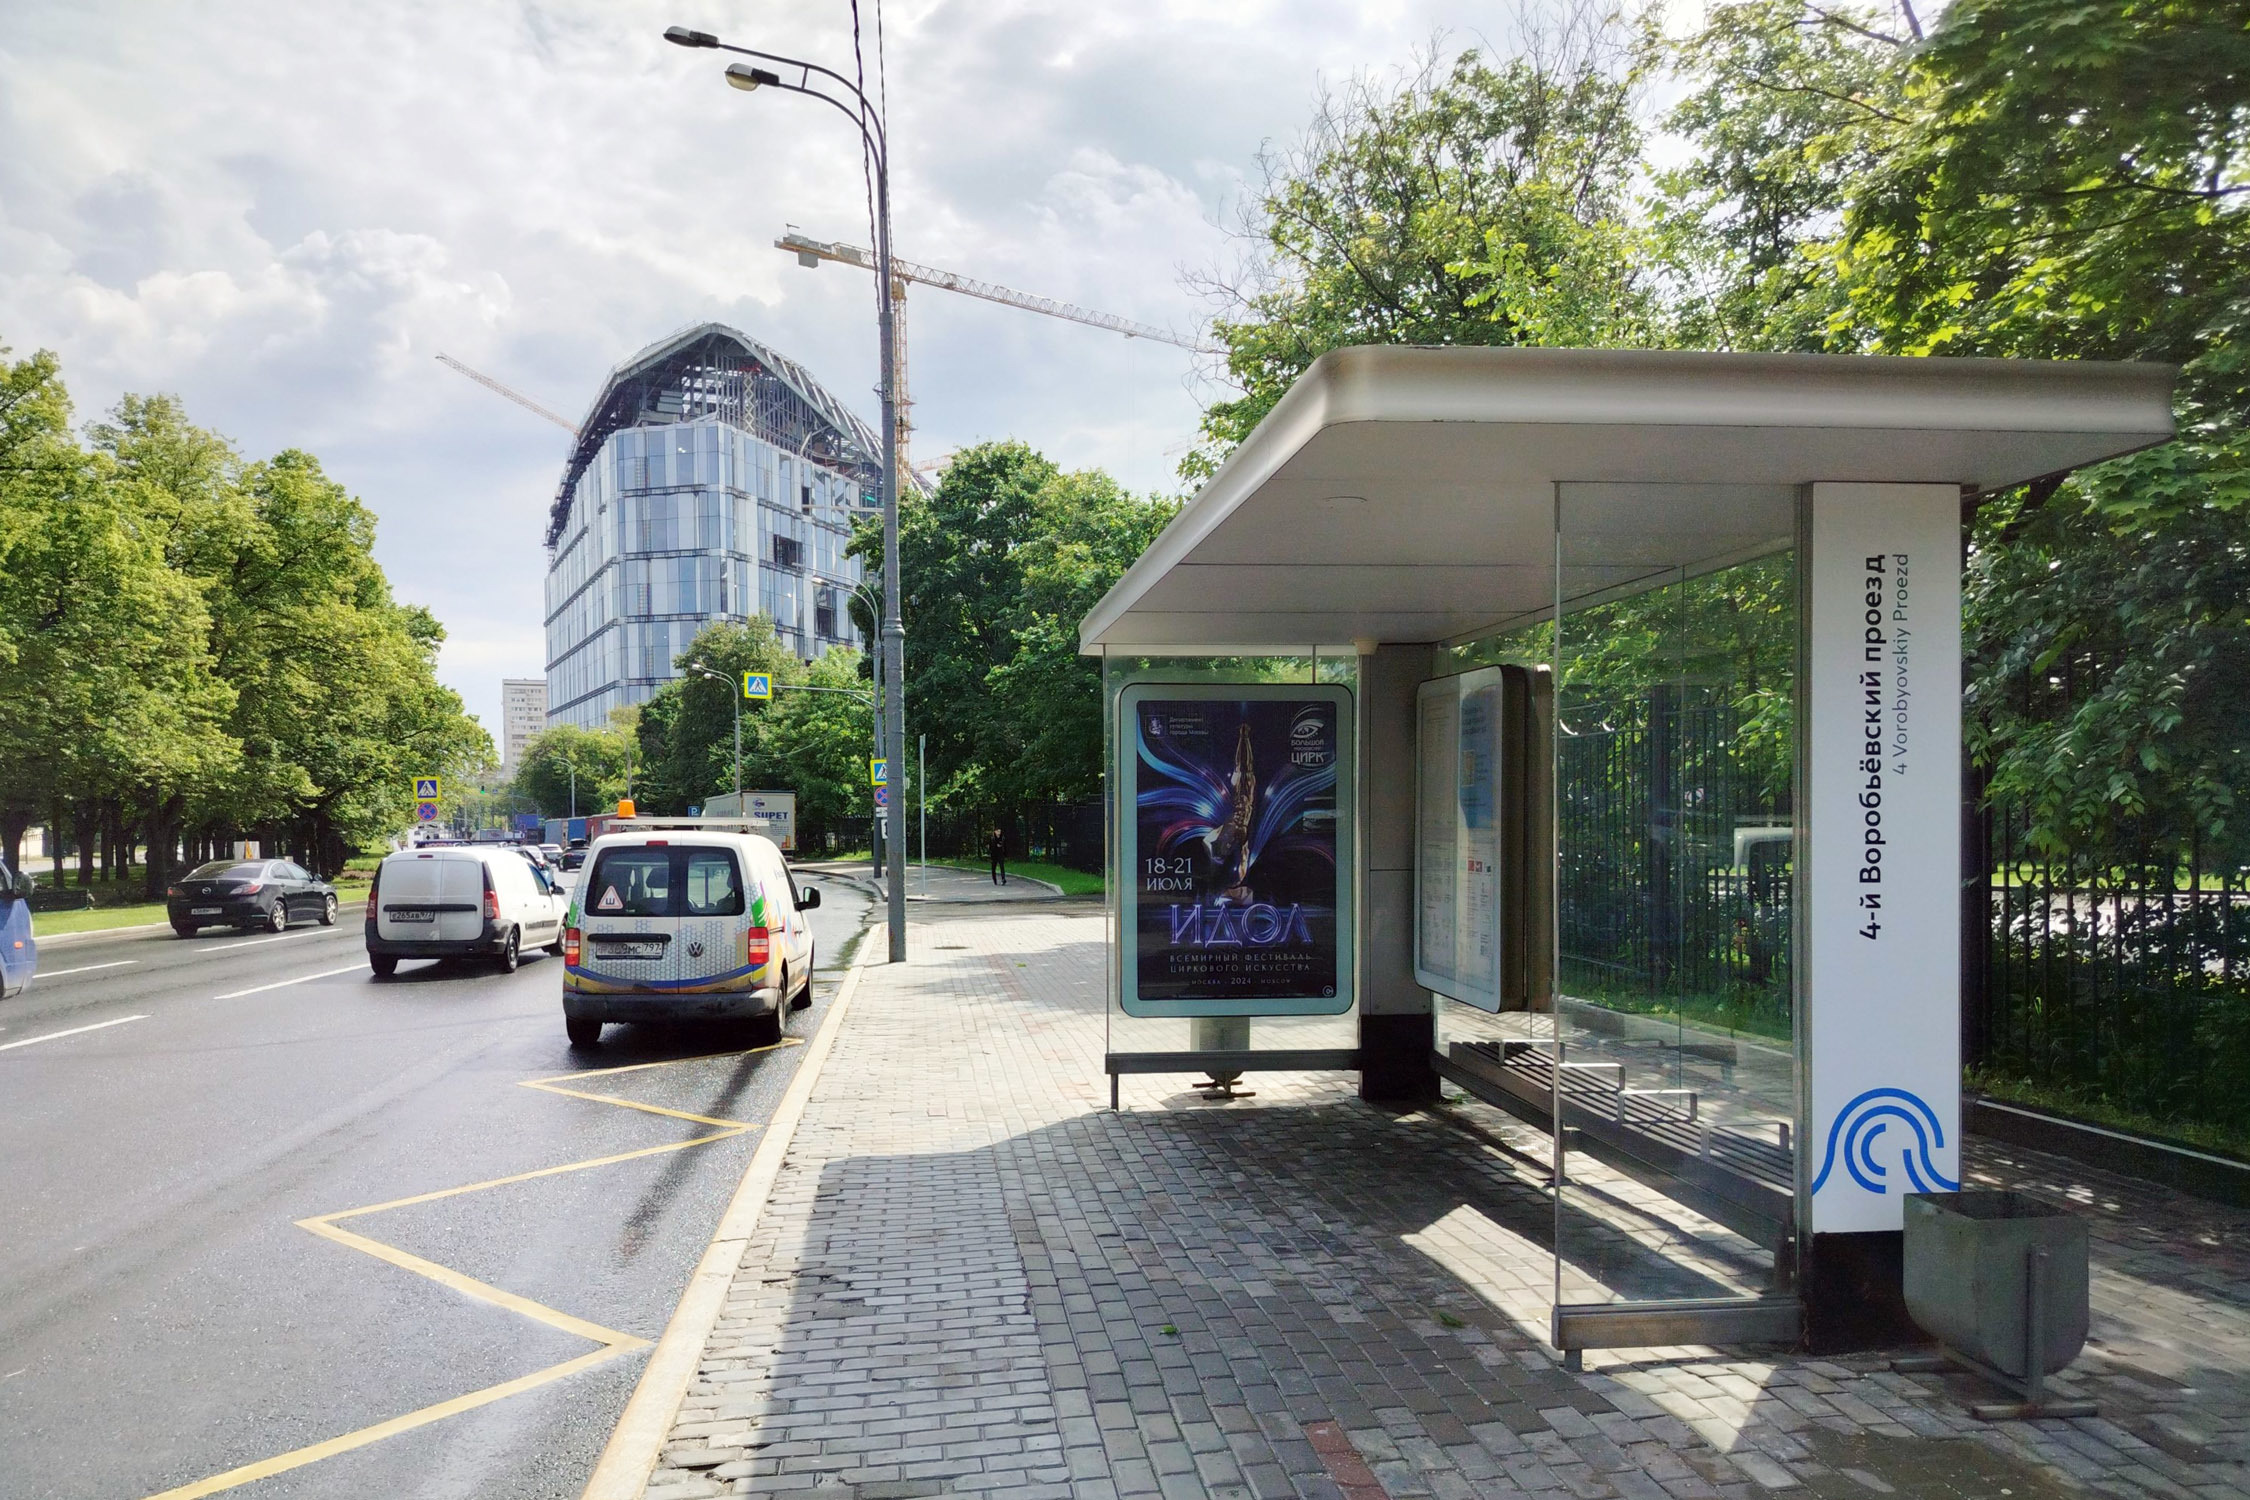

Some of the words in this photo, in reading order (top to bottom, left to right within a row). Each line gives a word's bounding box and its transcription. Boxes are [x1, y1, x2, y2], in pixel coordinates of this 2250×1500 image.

[1892, 553, 1908, 621] Proezd
[1865, 554, 1887, 662] проезд
[1892, 627, 1912, 757] Vorobyovskiy
[1291, 751, 1325, 765] ЦИРК
[1859, 671, 1886, 883] Воробьёвский
[1892, 762, 1908, 775] 4
[1145, 857, 1192, 874] 18-21
[1146, 877, 1193, 891] ИЮЛЯ
[1170, 902, 1312, 948] ИДОЛ
[1859, 893, 1882, 940] 4-й
[1169, 953, 1239, 963] ВСЕМИРНЫЙ
[1244, 952, 1312, 962] ФЕСТИВАЛЬ
[1170, 963, 1239, 973] ЦИРКОВОГО
[1245, 963, 1310, 972] ИСКУССТВА
[1231, 977, 1252, 985] 2024
